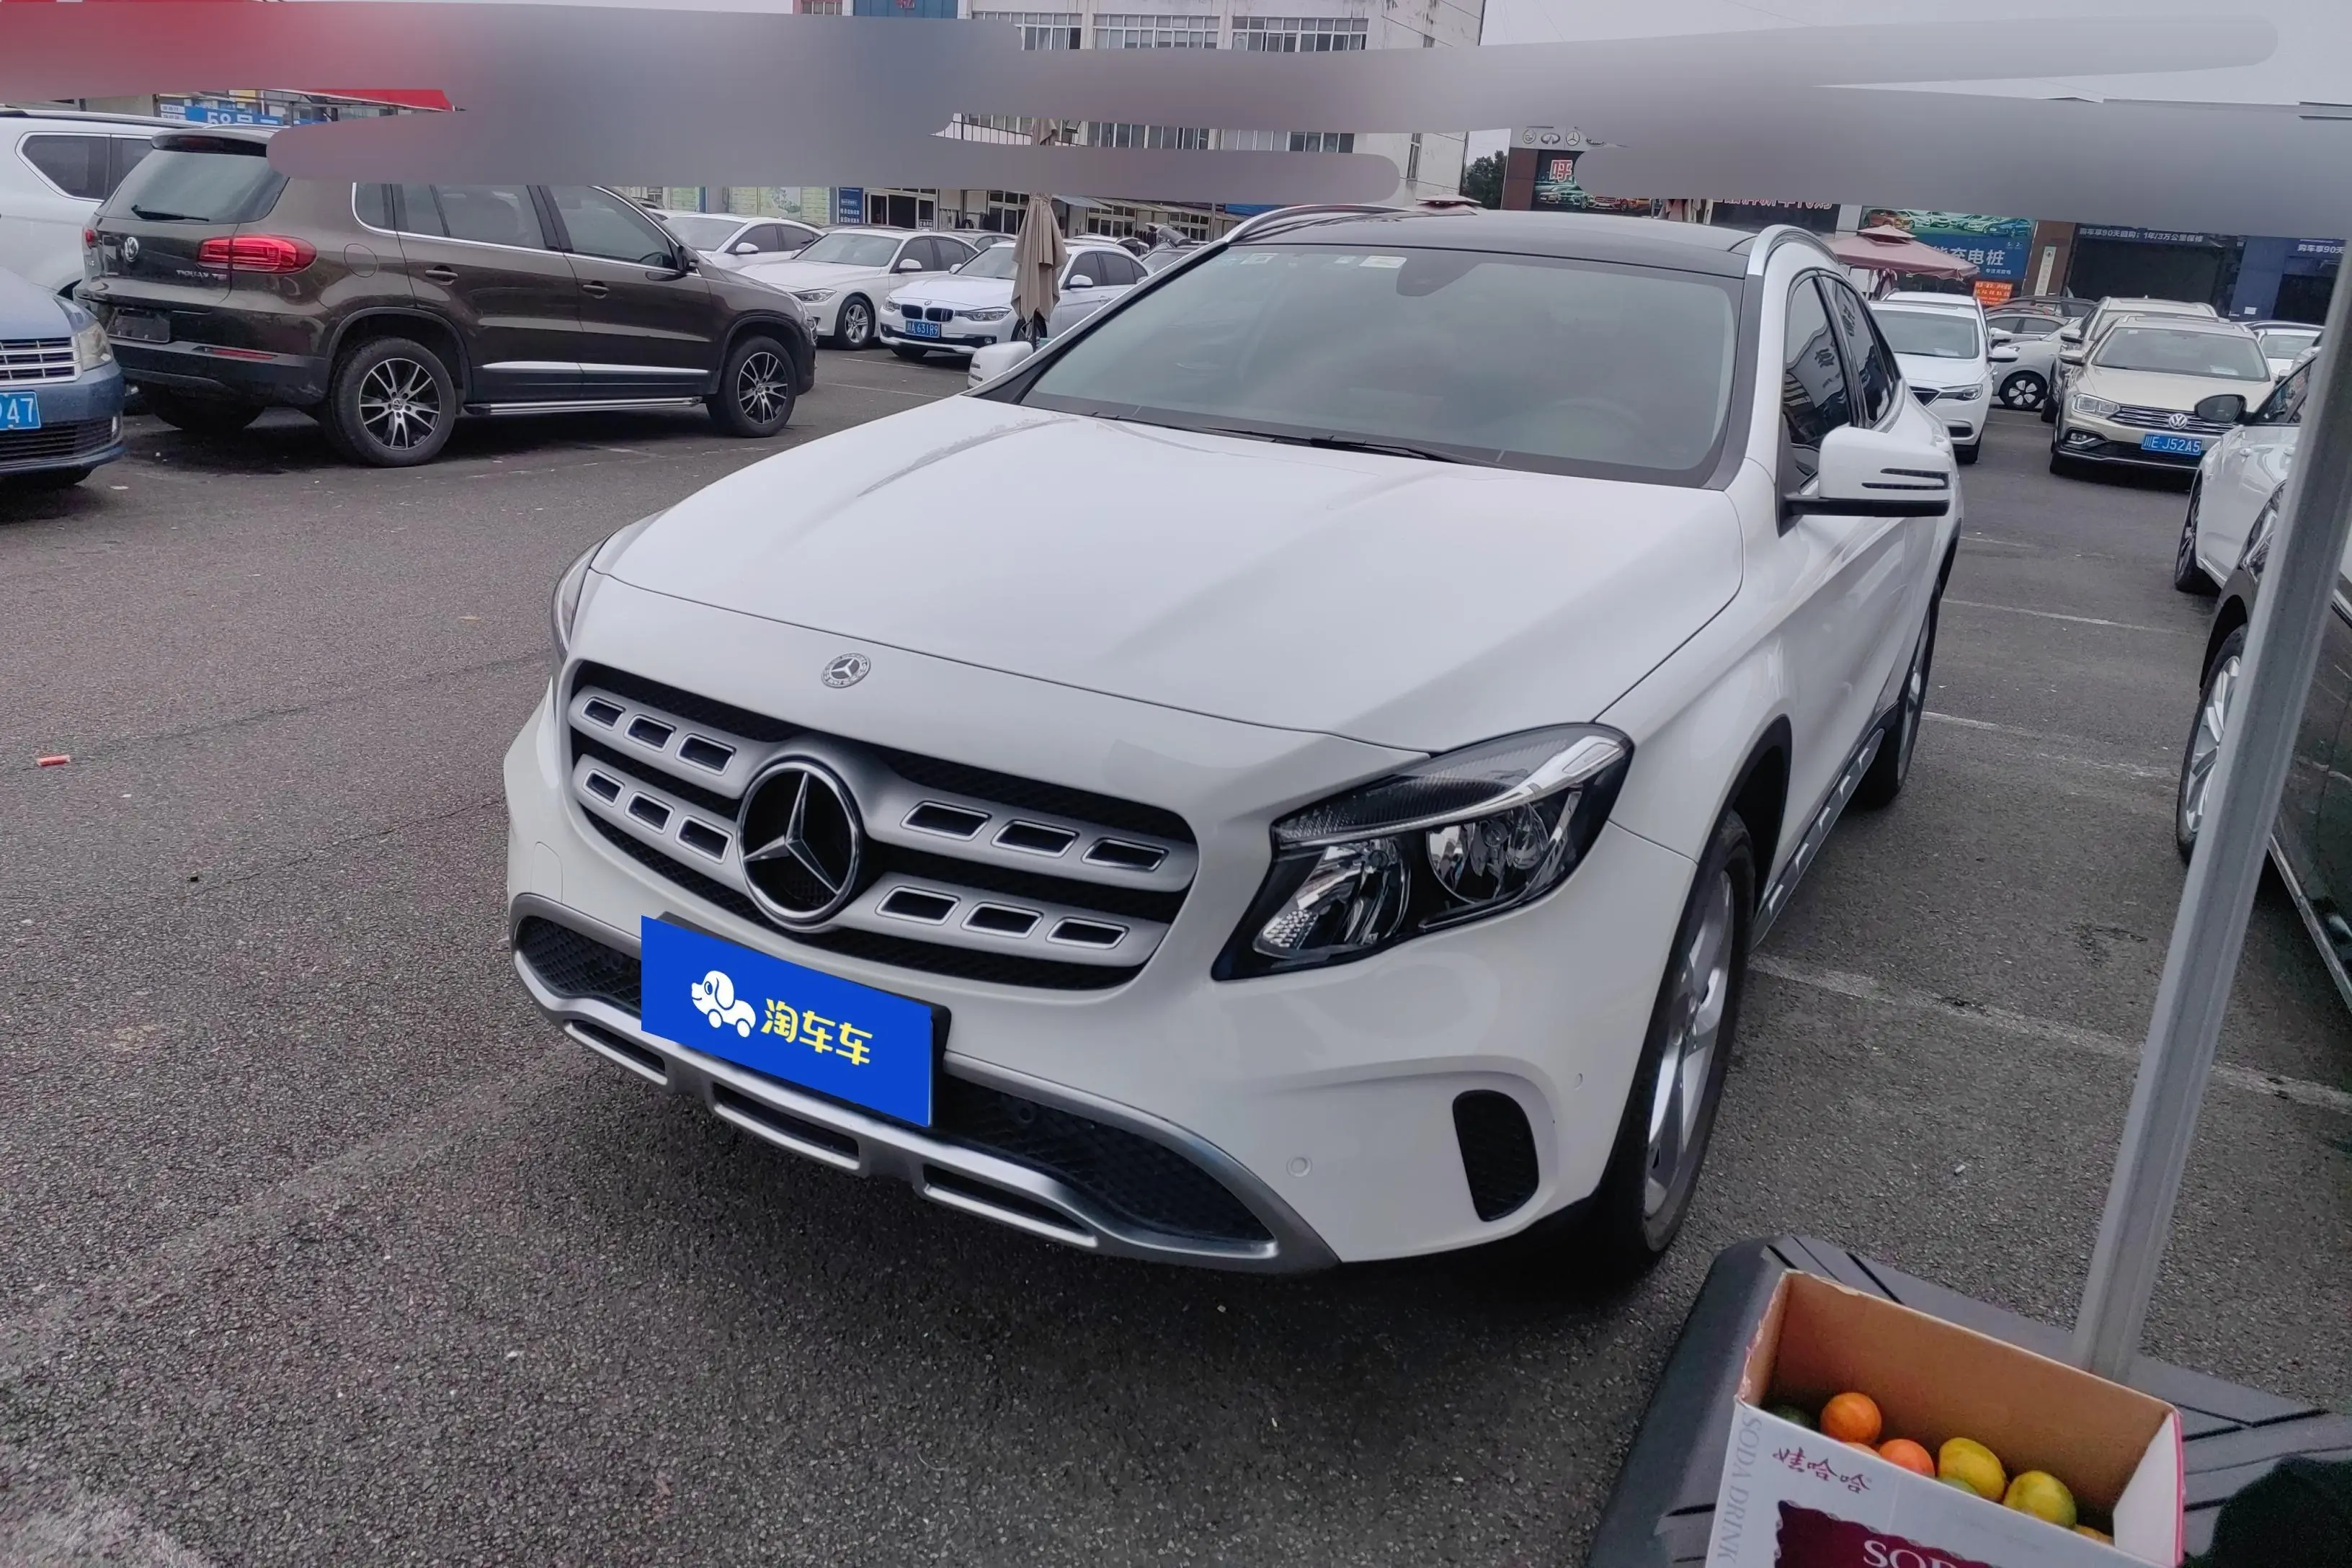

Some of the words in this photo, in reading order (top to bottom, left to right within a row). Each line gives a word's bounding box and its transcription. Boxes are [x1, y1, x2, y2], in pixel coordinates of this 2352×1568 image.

[0, 398, 34, 424] 47
[1732, 1412, 1763, 1478] SODA
[1773, 1447, 1871, 1494] 娃哈哈
[1717, 1485, 1750, 1564] DRINK
